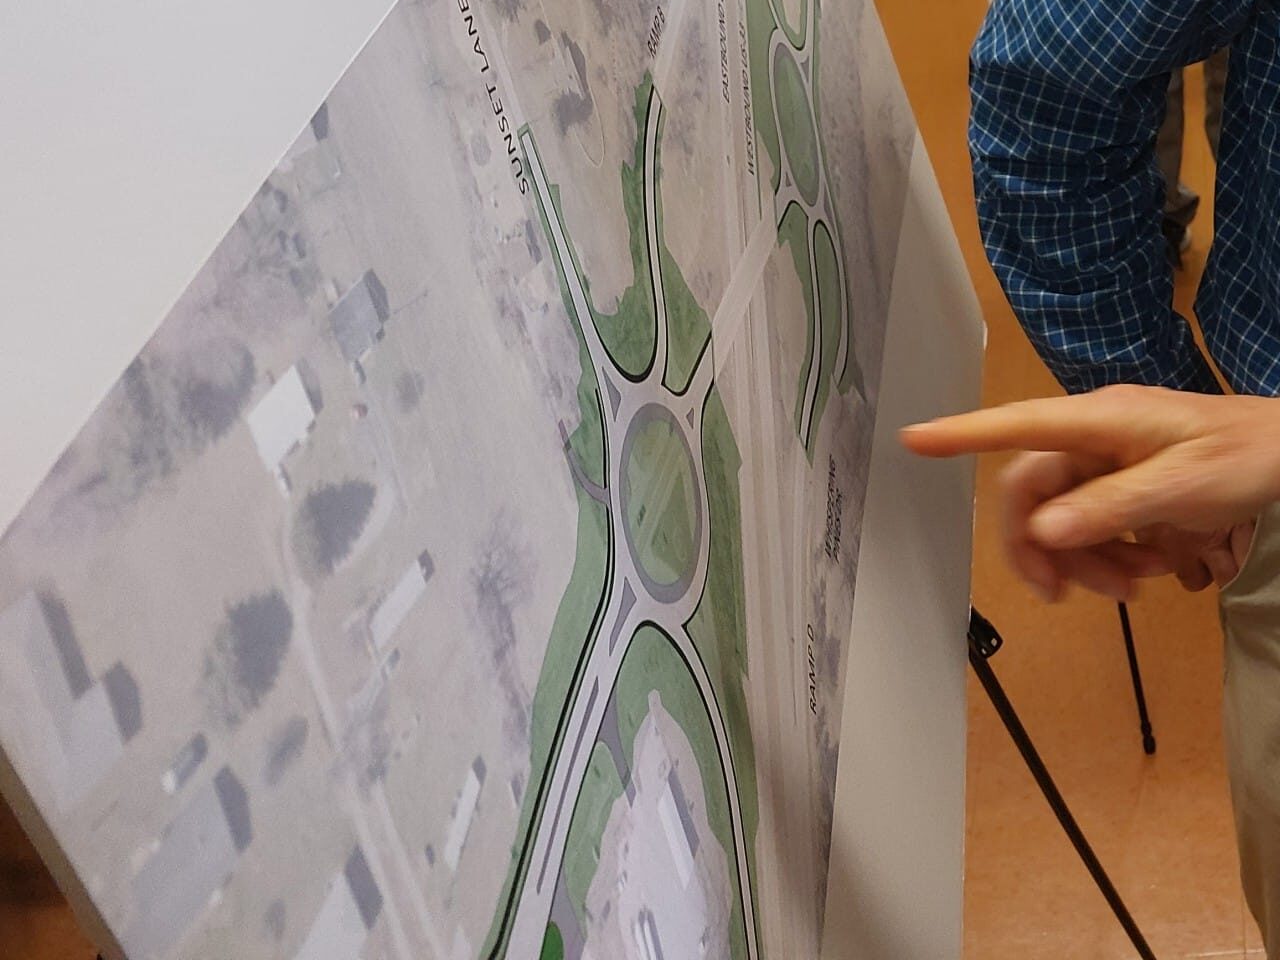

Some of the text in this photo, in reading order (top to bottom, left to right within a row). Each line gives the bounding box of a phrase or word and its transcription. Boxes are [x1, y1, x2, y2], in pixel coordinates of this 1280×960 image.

[647, 5, 665, 59] RAMP B
[717, 3, 730, 104] EASTBOUND
[485, 82, 530, 196] SUNSET
[741, 70, 755, 176] WESTBOUND
[806, 623, 817, 716] RAMP D
